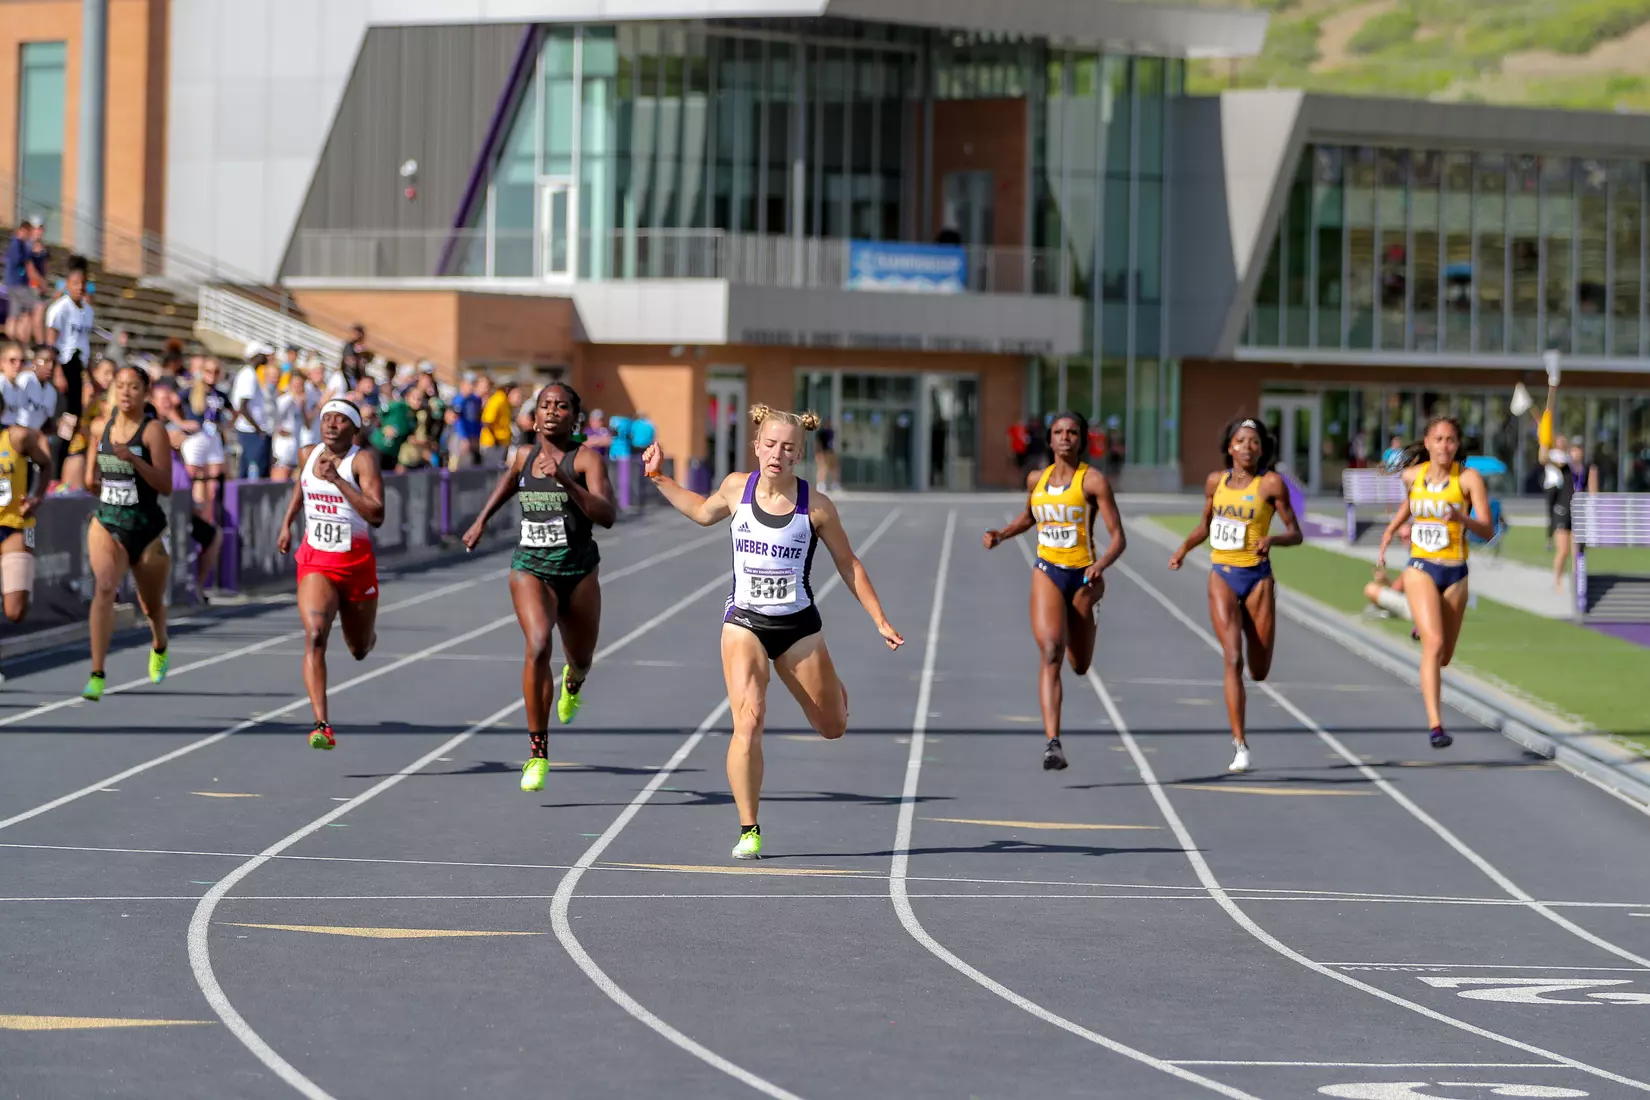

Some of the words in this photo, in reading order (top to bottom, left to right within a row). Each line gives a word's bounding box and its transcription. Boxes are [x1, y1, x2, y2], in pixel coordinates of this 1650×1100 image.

[1031, 503, 1085, 523] UNC
[314, 523, 343, 543] 491
[527, 524, 559, 543] 445
[1214, 523, 1239, 544] 364
[735, 538, 769, 556] WEBER
[771, 544, 803, 559] STATE
[750, 576, 788, 600] 538
